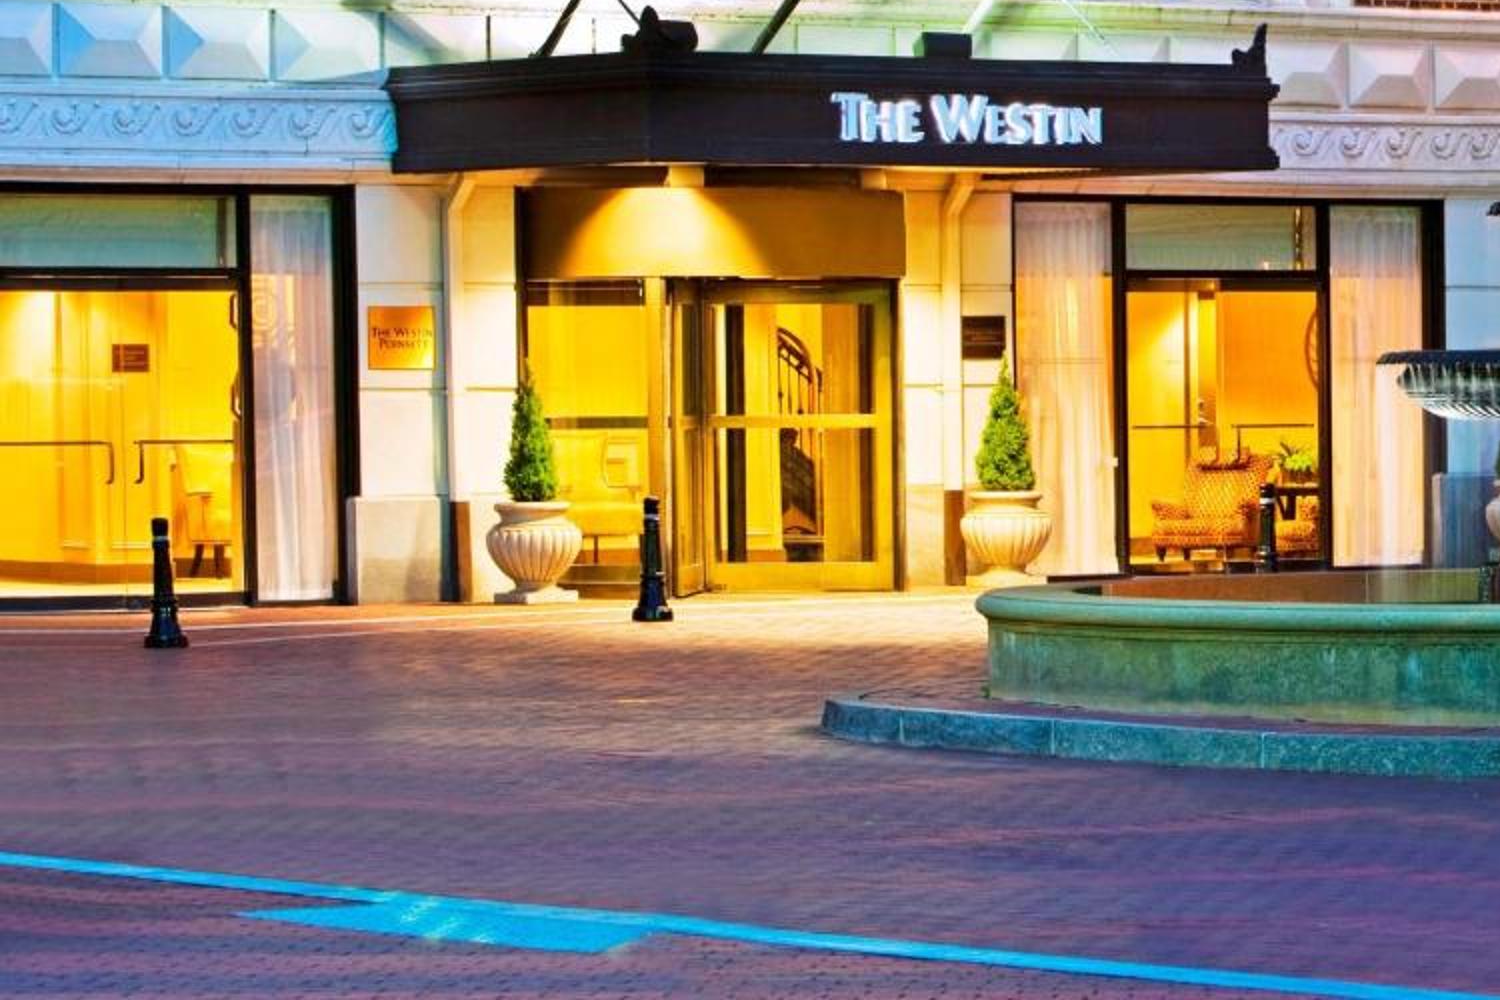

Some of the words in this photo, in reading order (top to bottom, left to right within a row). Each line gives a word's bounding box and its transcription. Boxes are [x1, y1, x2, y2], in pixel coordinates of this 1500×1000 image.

[831, 91, 924, 143] THE
[930, 93, 1103, 145] WESTIN
[372, 327, 391, 338] THE
